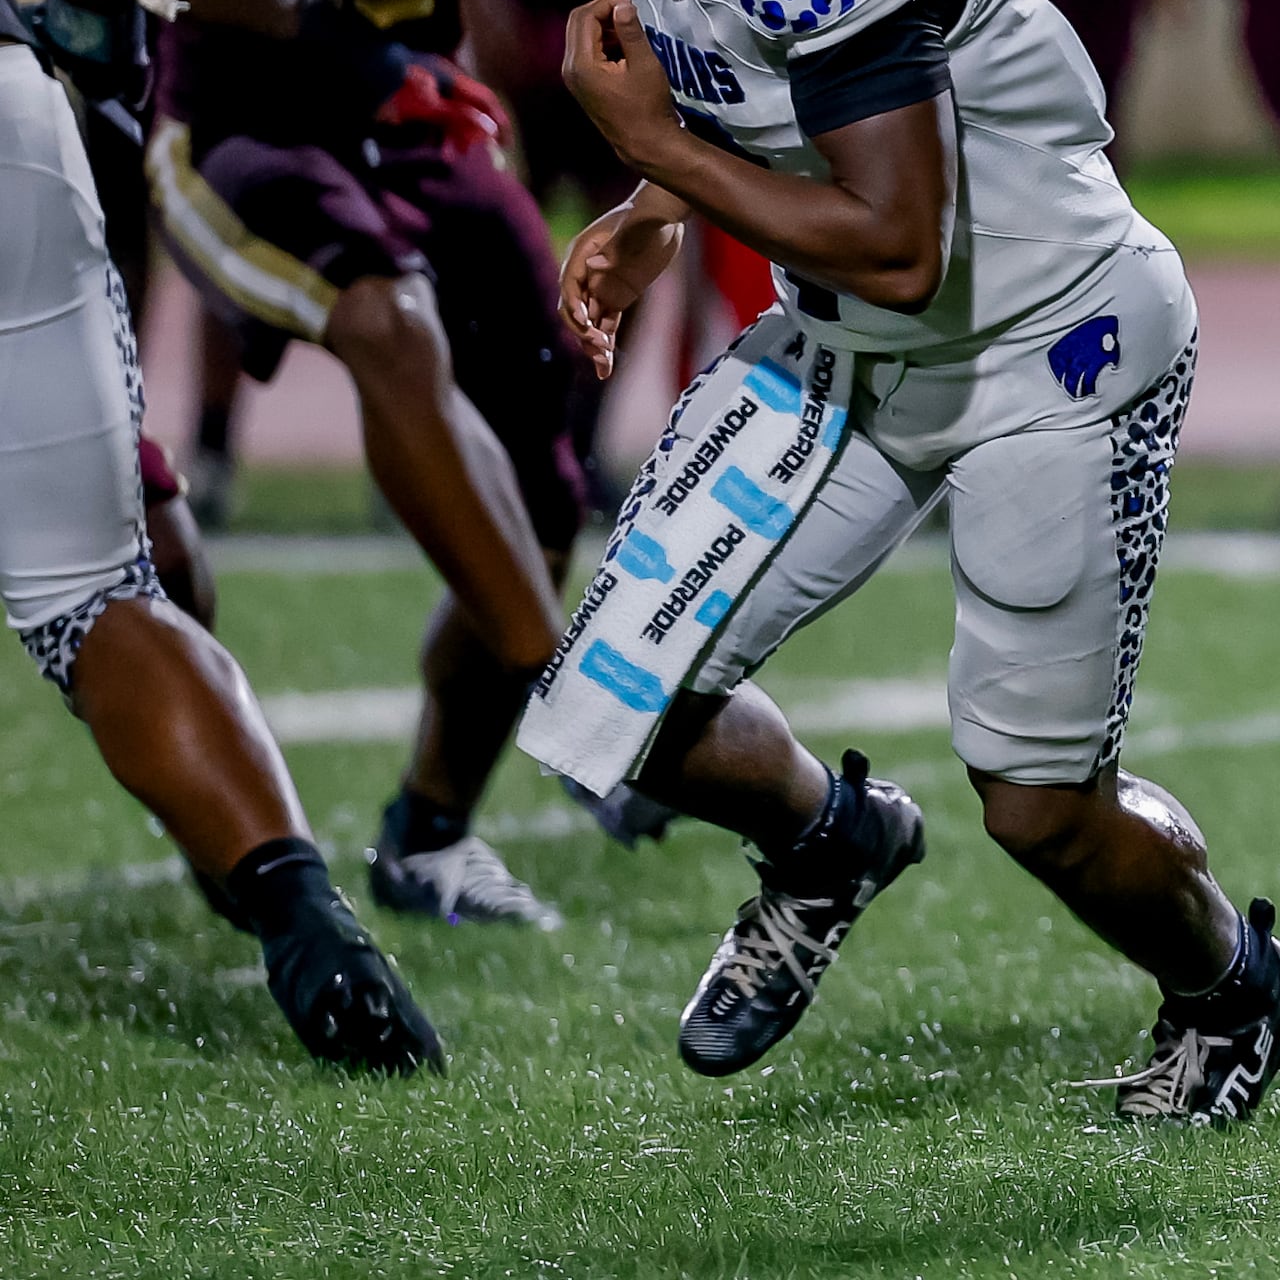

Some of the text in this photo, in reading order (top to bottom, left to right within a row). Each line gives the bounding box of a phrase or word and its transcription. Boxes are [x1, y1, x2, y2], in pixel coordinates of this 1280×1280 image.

[653, 395, 760, 517] POWERADE
[768, 342, 837, 485] POWERADE
[533, 572, 619, 699] POWERADE
[640, 523, 747, 645] POWERADE
